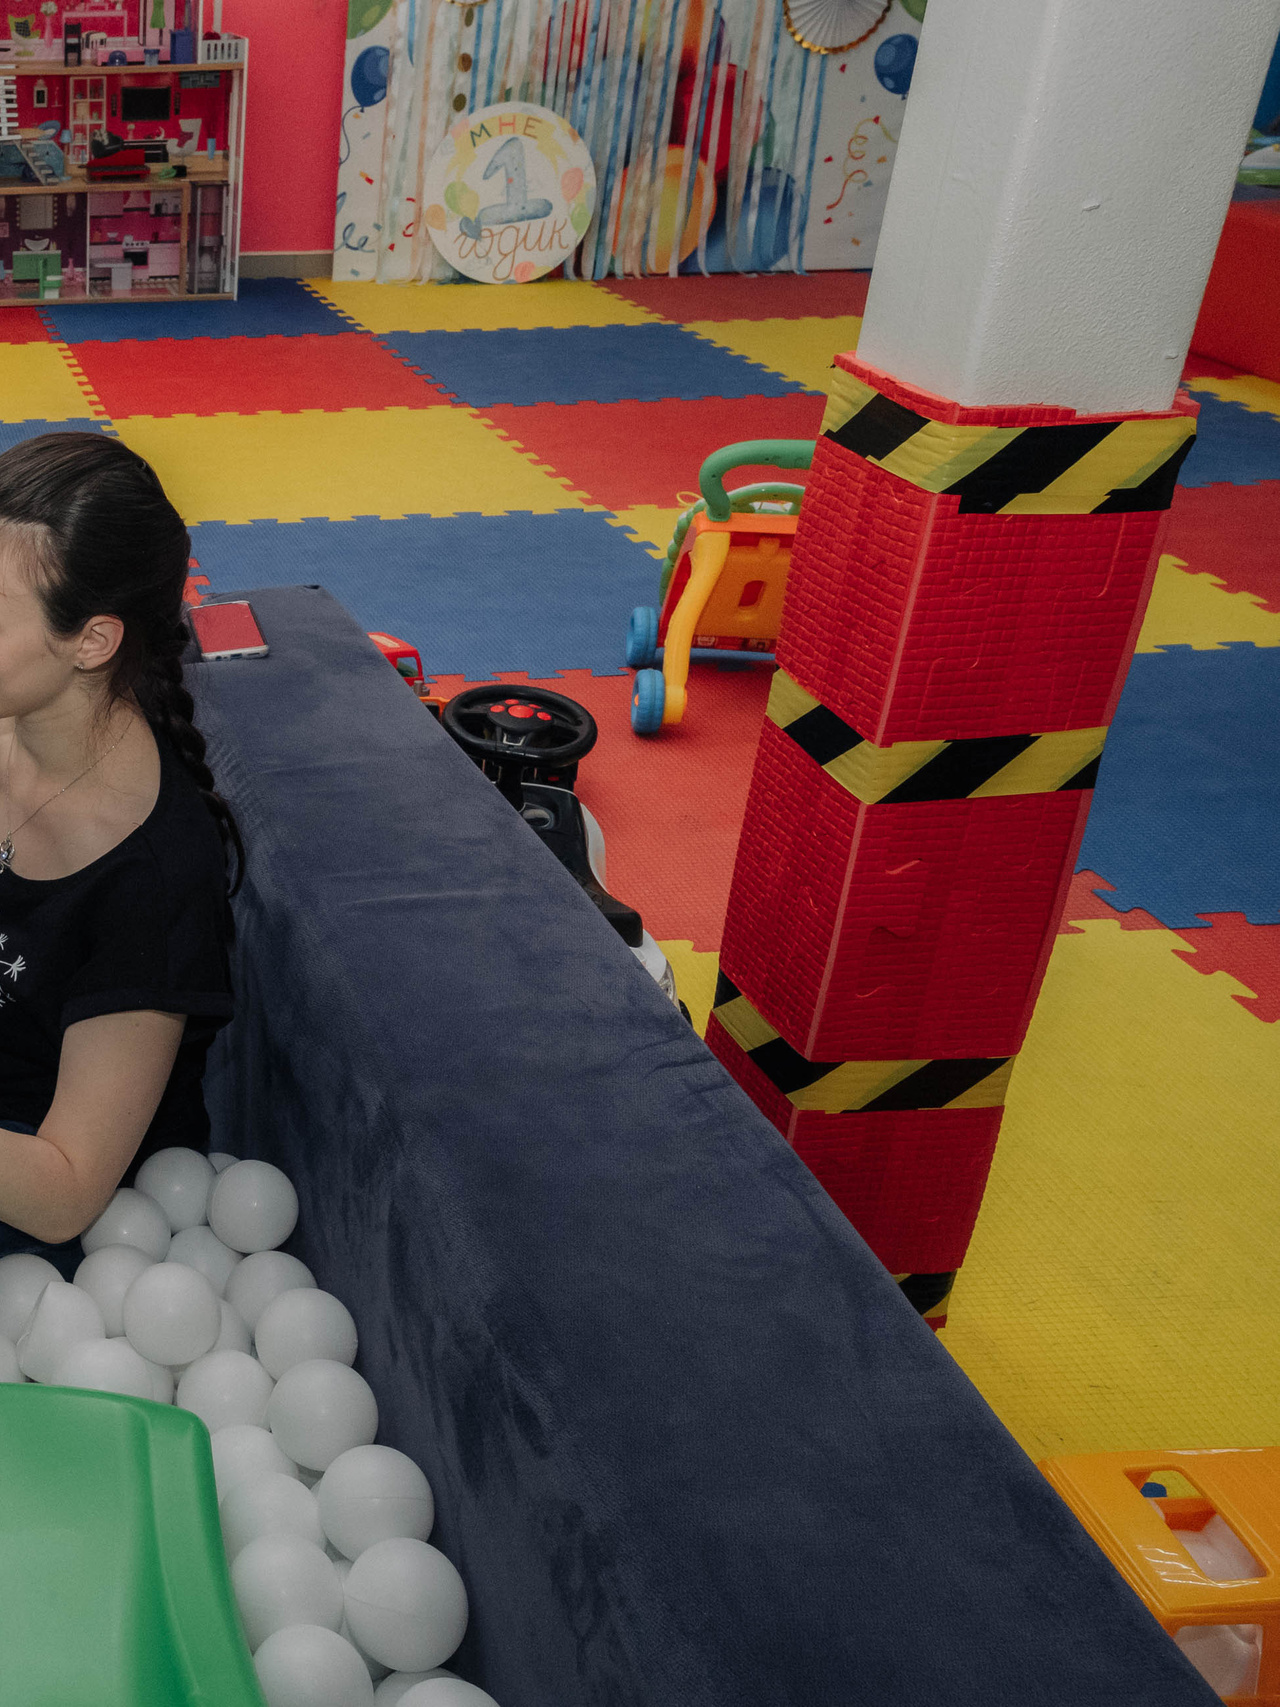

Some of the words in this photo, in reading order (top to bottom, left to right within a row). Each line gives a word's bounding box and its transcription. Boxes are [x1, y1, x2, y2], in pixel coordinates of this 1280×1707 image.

[470, 114, 542, 147] МНЕ
[478, 137, 553, 226] 1
[454, 218, 569, 281] годик
